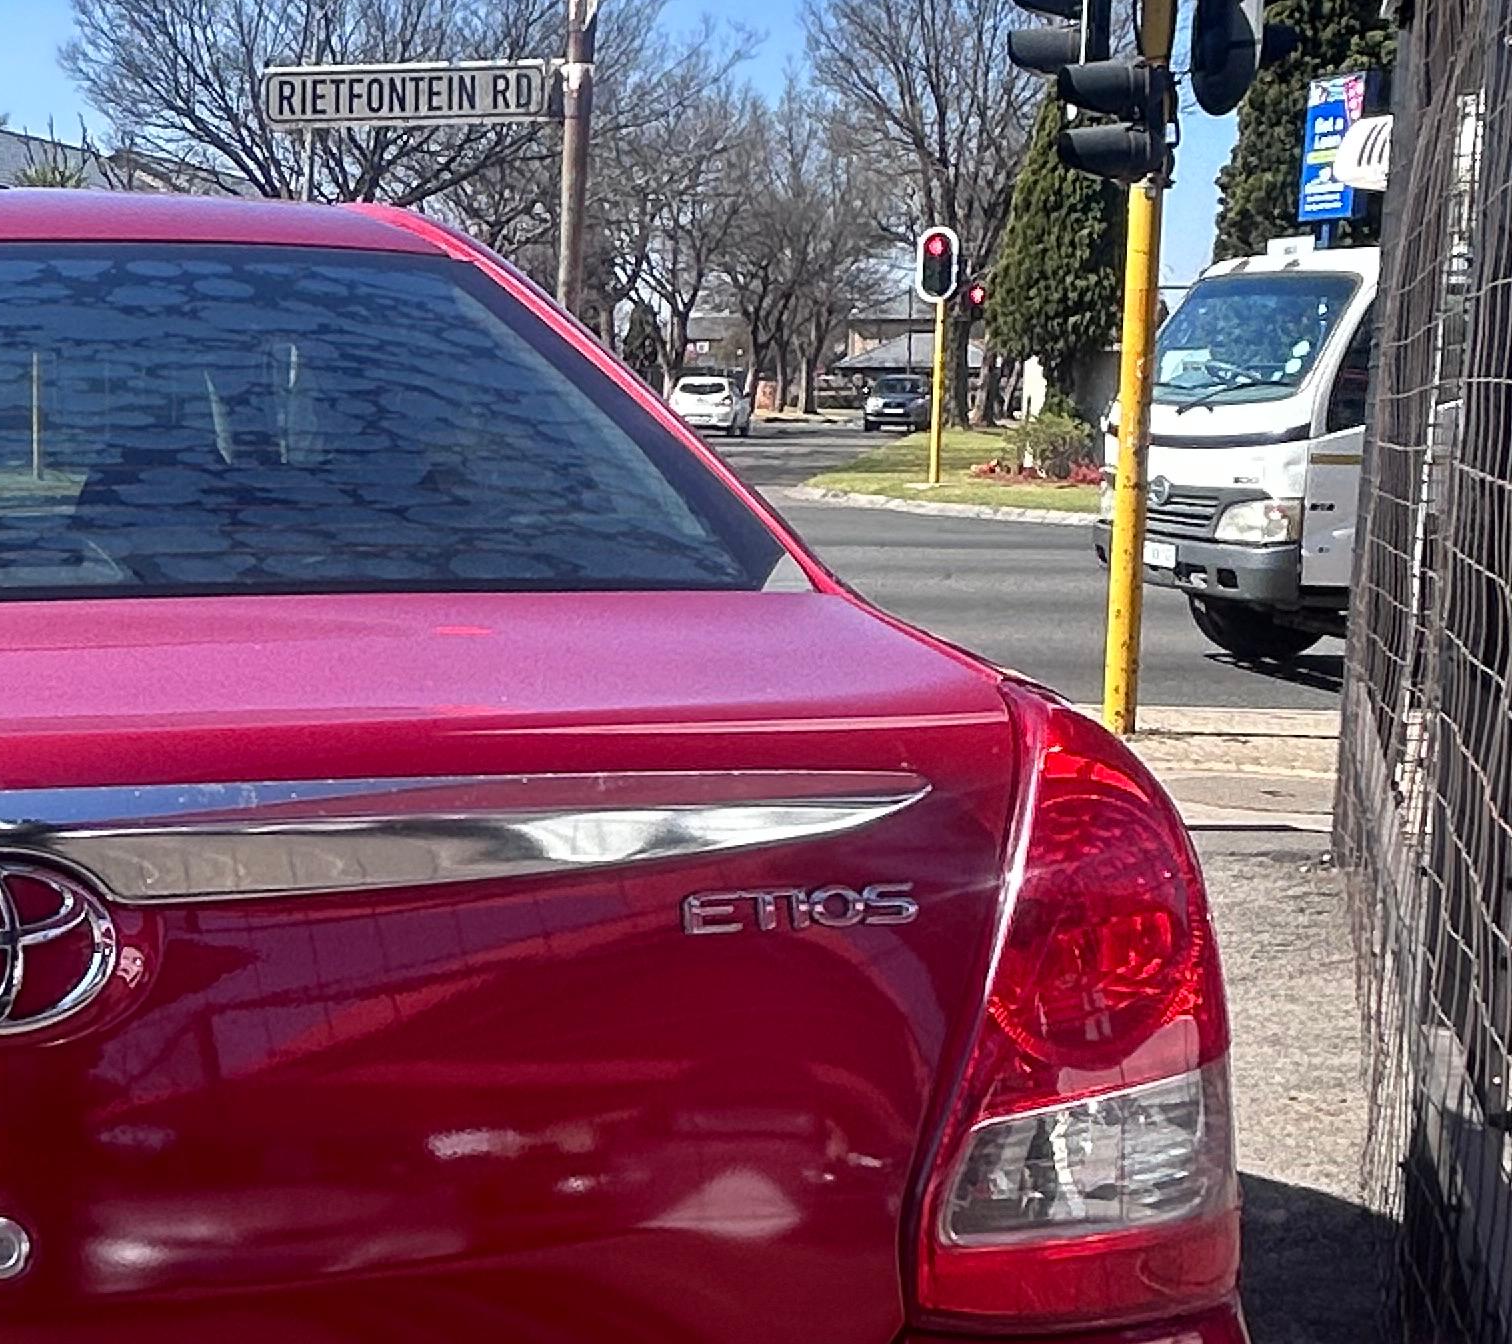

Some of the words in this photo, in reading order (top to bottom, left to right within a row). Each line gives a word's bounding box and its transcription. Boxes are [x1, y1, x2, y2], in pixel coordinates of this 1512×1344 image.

[278, 74, 476, 116] RIETFONTEIN
[492, 73, 533, 110] RD
[684, 882, 919, 935] ETIOS
